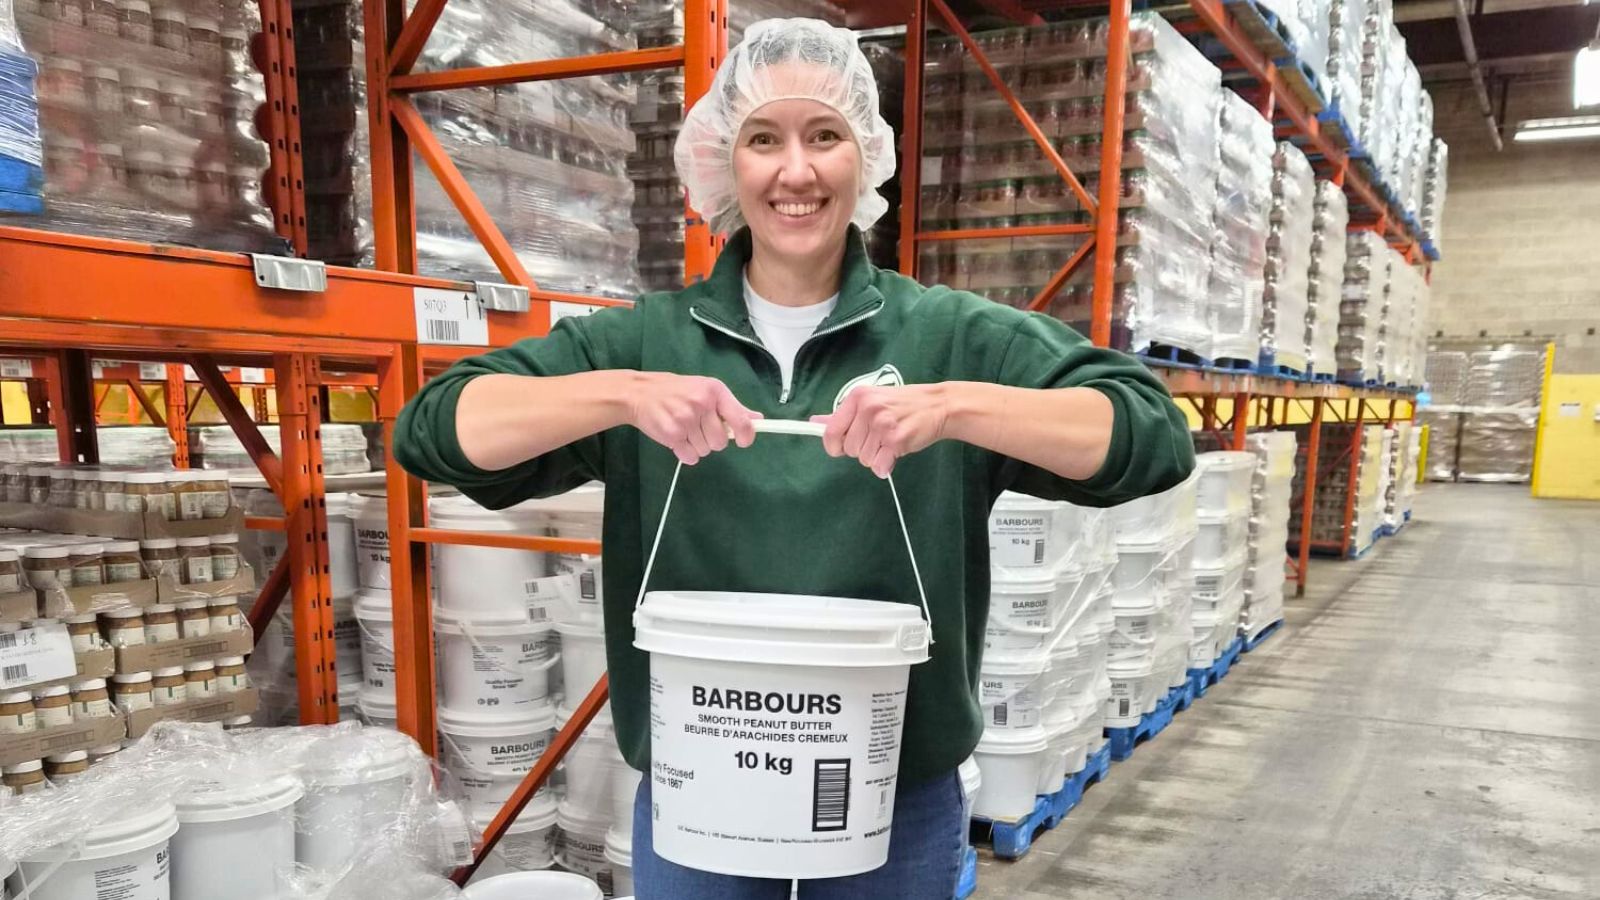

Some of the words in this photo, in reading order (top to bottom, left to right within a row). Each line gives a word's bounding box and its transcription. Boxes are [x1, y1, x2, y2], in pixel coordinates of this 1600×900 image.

[996, 518, 1043, 526] BARBOURS
[692, 685, 842, 715] BARBOURS
[698, 713, 740, 727] SMOOTH
[744, 718, 787, 730] PEANUT
[790, 721, 832, 731] BUTTER
[684, 723, 720, 737] BEURRE
[723, 729, 795, 743] D'ARACHIDES
[798, 733, 848, 743] CREMEUX
[663, 763, 694, 780] Focused
[735, 751, 759, 769] 10
[765, 752, 793, 775] kg
